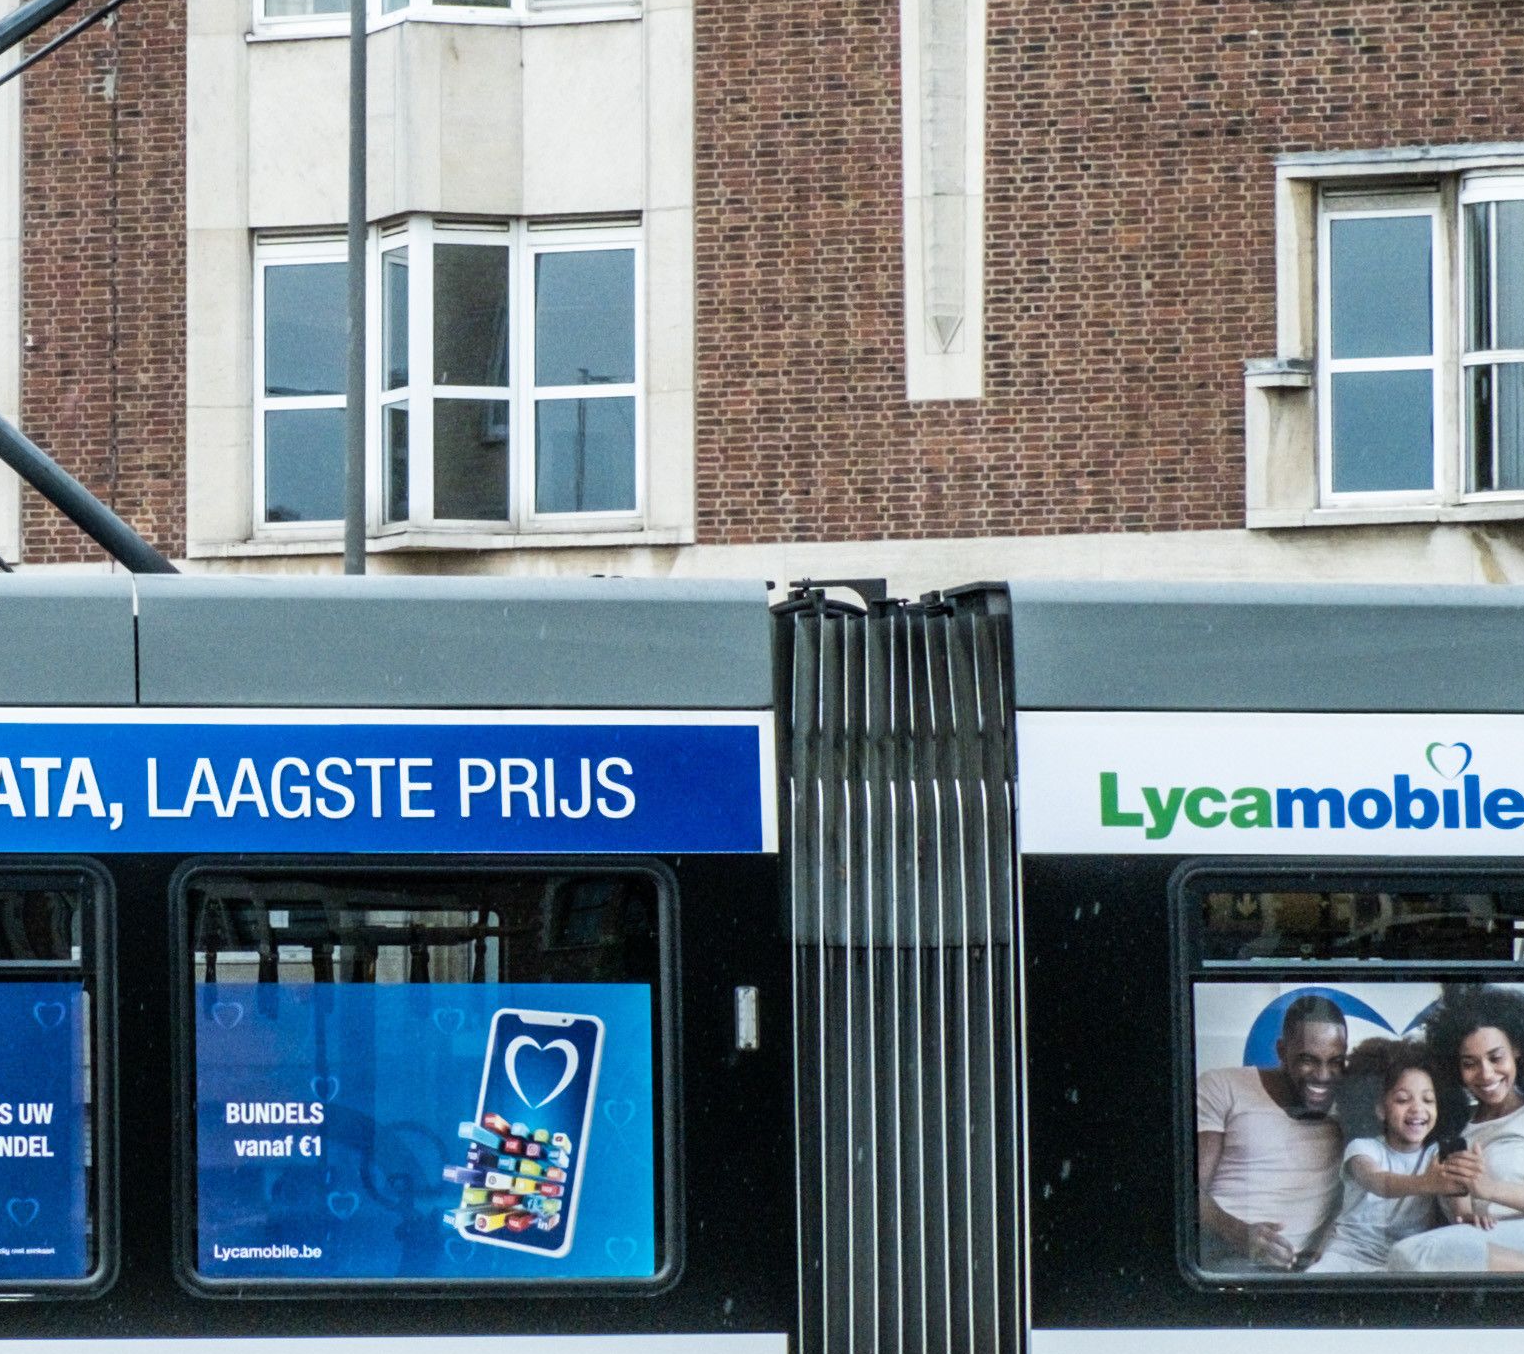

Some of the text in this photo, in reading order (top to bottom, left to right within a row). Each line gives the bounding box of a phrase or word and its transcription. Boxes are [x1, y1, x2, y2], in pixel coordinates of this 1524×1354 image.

[147, 757, 437, 821] LAAGSTE
[459, 756, 638, 821] PRIJS
[18, 1103, 55, 1126] UW
[226, 1102, 326, 1126] BUNDELS
[234, 1135, 323, 1158] vanaf €1
[213, 1243, 324, 1263] Lycamobile.be
